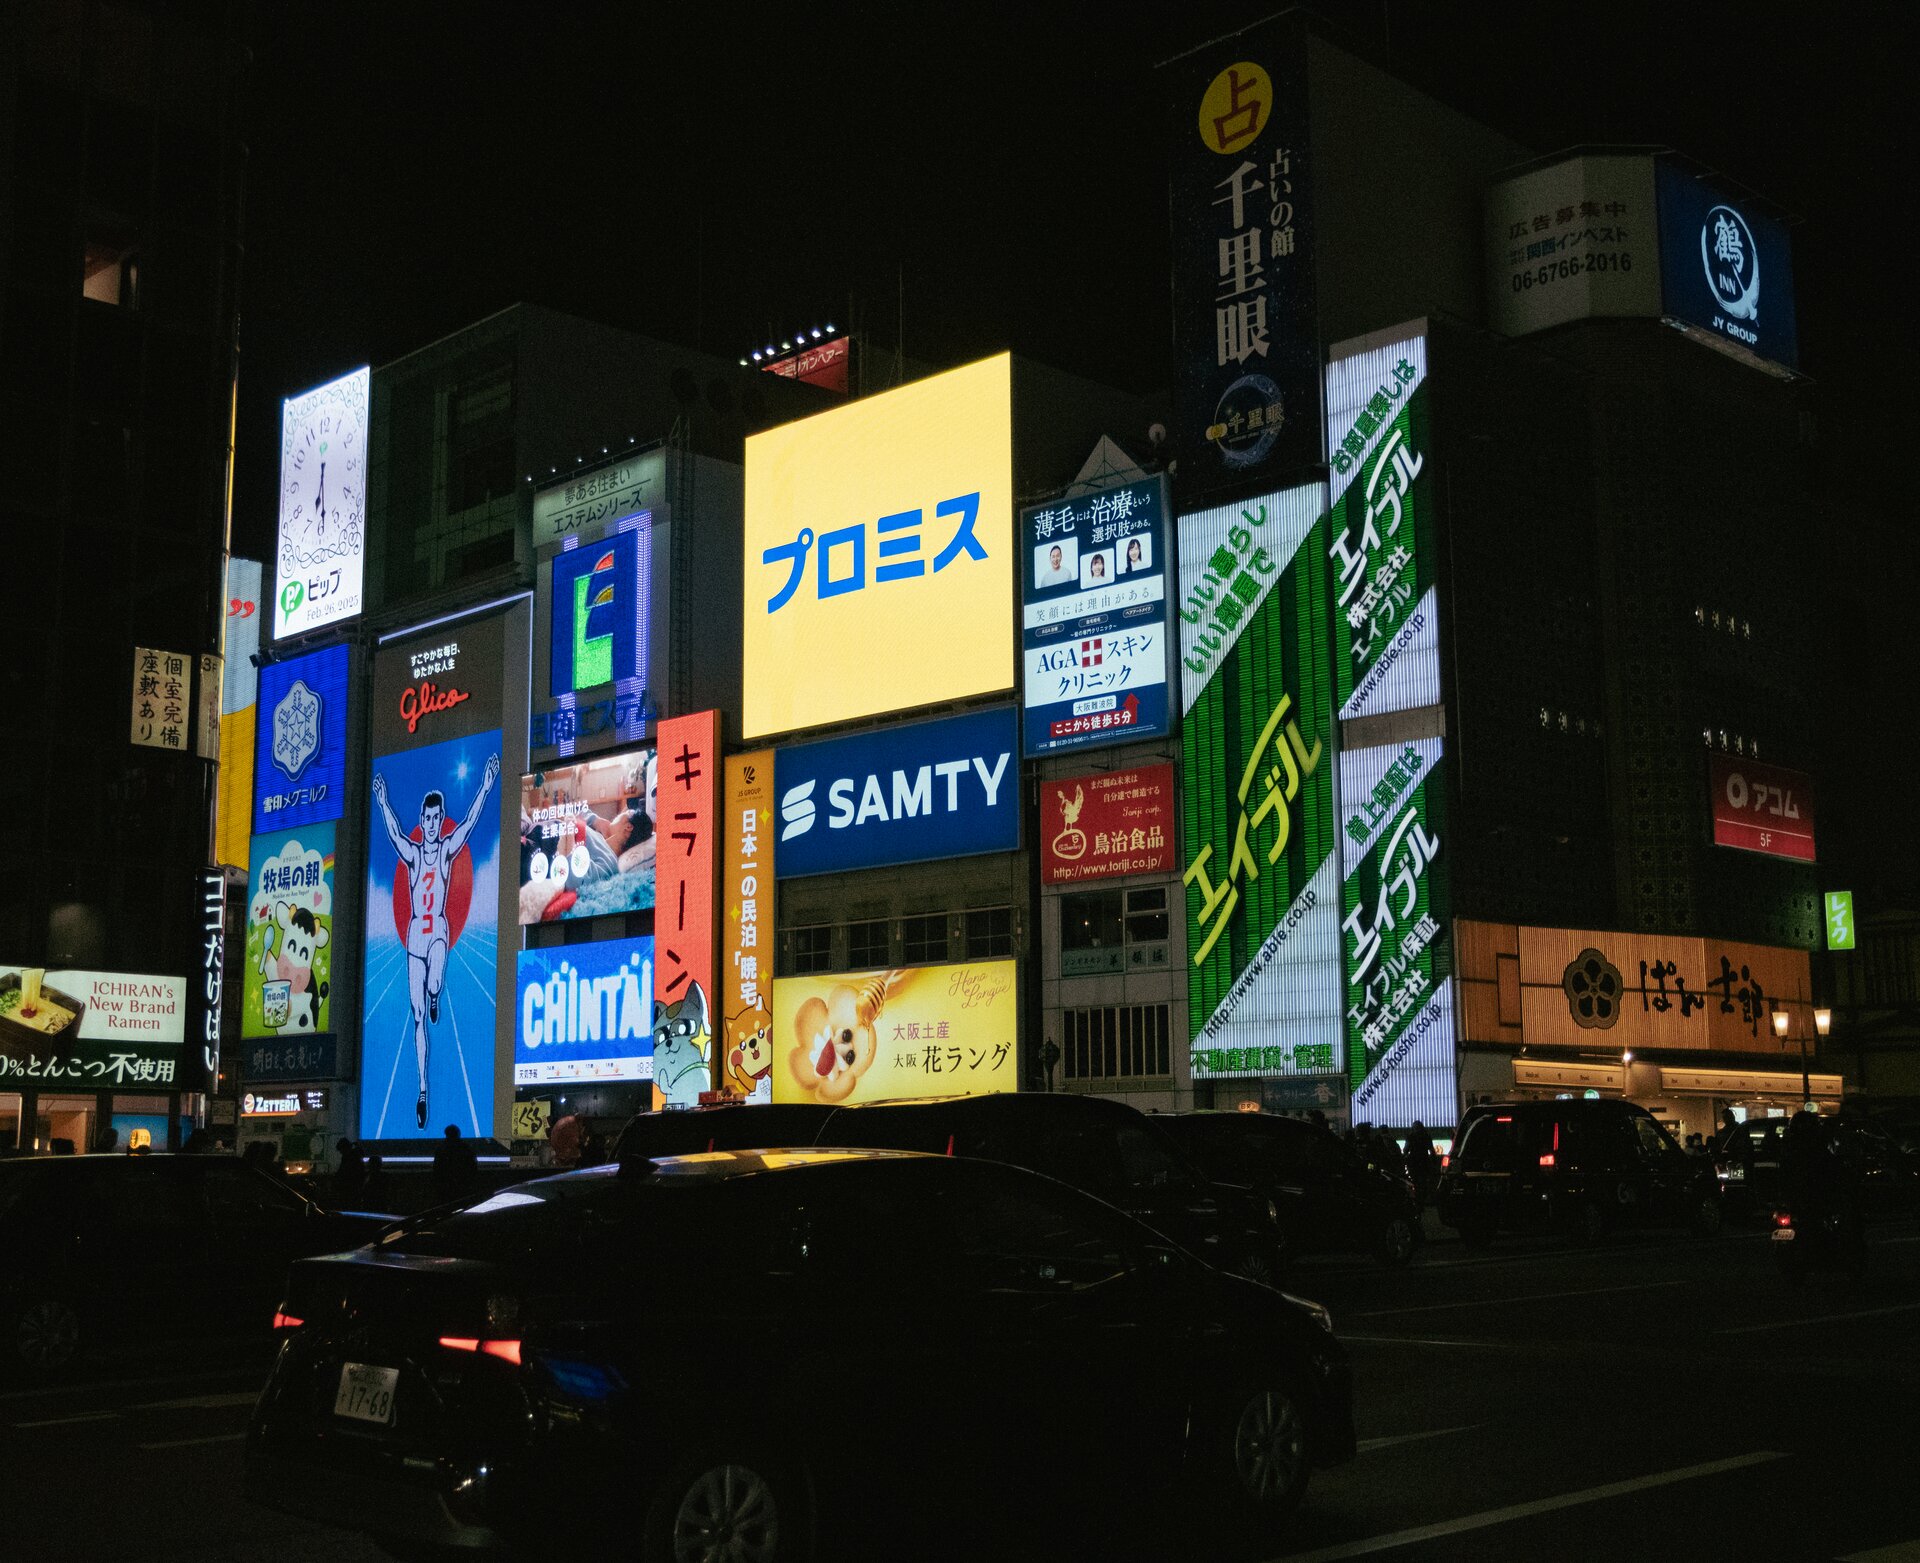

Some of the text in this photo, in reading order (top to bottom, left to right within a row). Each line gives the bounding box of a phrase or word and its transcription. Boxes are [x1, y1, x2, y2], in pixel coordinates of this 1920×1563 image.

[1212, 70, 1260, 150] 占
[1269, 148, 1296, 260] 占いの館
[1508, 201, 1626, 240] 広告募集中
[1211, 159, 1271, 367] 千里眼
[1714, 213, 1745, 274] 鶴
[1512, 252, 1632, 293] 06-6766-2016
[1718, 272, 1736, 296] INN
[1712, 315, 1758, 345] JY GROUP
[1330, 358, 1417, 475] お部屋探しは
[553, 490, 643, 535] エステムシリーズ
[564, 468, 632, 506] 夢ある住まい
[1034, 490, 1151, 541] 薄毛には治療という
[1328, 428, 1423, 608] エイブル
[762, 491, 989, 615] プロミス
[1179, 504, 1267, 625] いい暮らし
[307, 567, 343, 602] ピップ
[1183, 546, 1276, 674] いい部屋で
[1346, 544, 1413, 630] 株式会社
[1350, 582, 1412, 664] エイブル
[413, 657, 455, 679] ゆたかな人生
[1036, 634, 1154, 674] AGA スキン
[1350, 613, 1425, 713] www.able.co.jp
[137, 651, 160, 742] 座敷あり
[160, 655, 184, 749] 個室完備
[1058, 664, 1132, 698] クリニック
[399, 681, 469, 734] Glico
[1054, 710, 1132, 735] ここから徒歩5分
[262, 784, 328, 814] 雪印メグミルク
[828, 752, 1011, 829] SAMTY
[1752, 782, 1800, 820] アコム
[1092, 825, 1164, 856] 鳥治食品
[1182, 693, 1321, 967] エイブル
[1759, 832, 1772, 848] 5F
[263, 860, 320, 895] 牧場の朝
[666, 744, 701, 993] キラーン
[1053, 855, 1163, 879] http://www.toriji.co.jp/
[420, 867, 438, 937] グリコ
[1341, 806, 1440, 986] エイブル
[1831, 894, 1848, 945] レイク
[93, 980, 174, 999] ICHIRAN's
[1203, 887, 1318, 1040] http://www.able.co.jp
[1346, 911, 1441, 1029] エイブル保証
[90, 996, 176, 1015] New Brand
[108, 1014, 160, 1030] Ramen
[524, 951, 652, 1049] CHINTAI
[1361, 968, 1431, 1052] 株式会社
[893, 1020, 950, 1041] 大阪土産
[1356, 1001, 1443, 1107] www.a-hosho.co.jp
[1190, 1043, 1334, 1073] 不動産賃貸・管理
[255, 1096, 301, 1113] ZETTERIA
